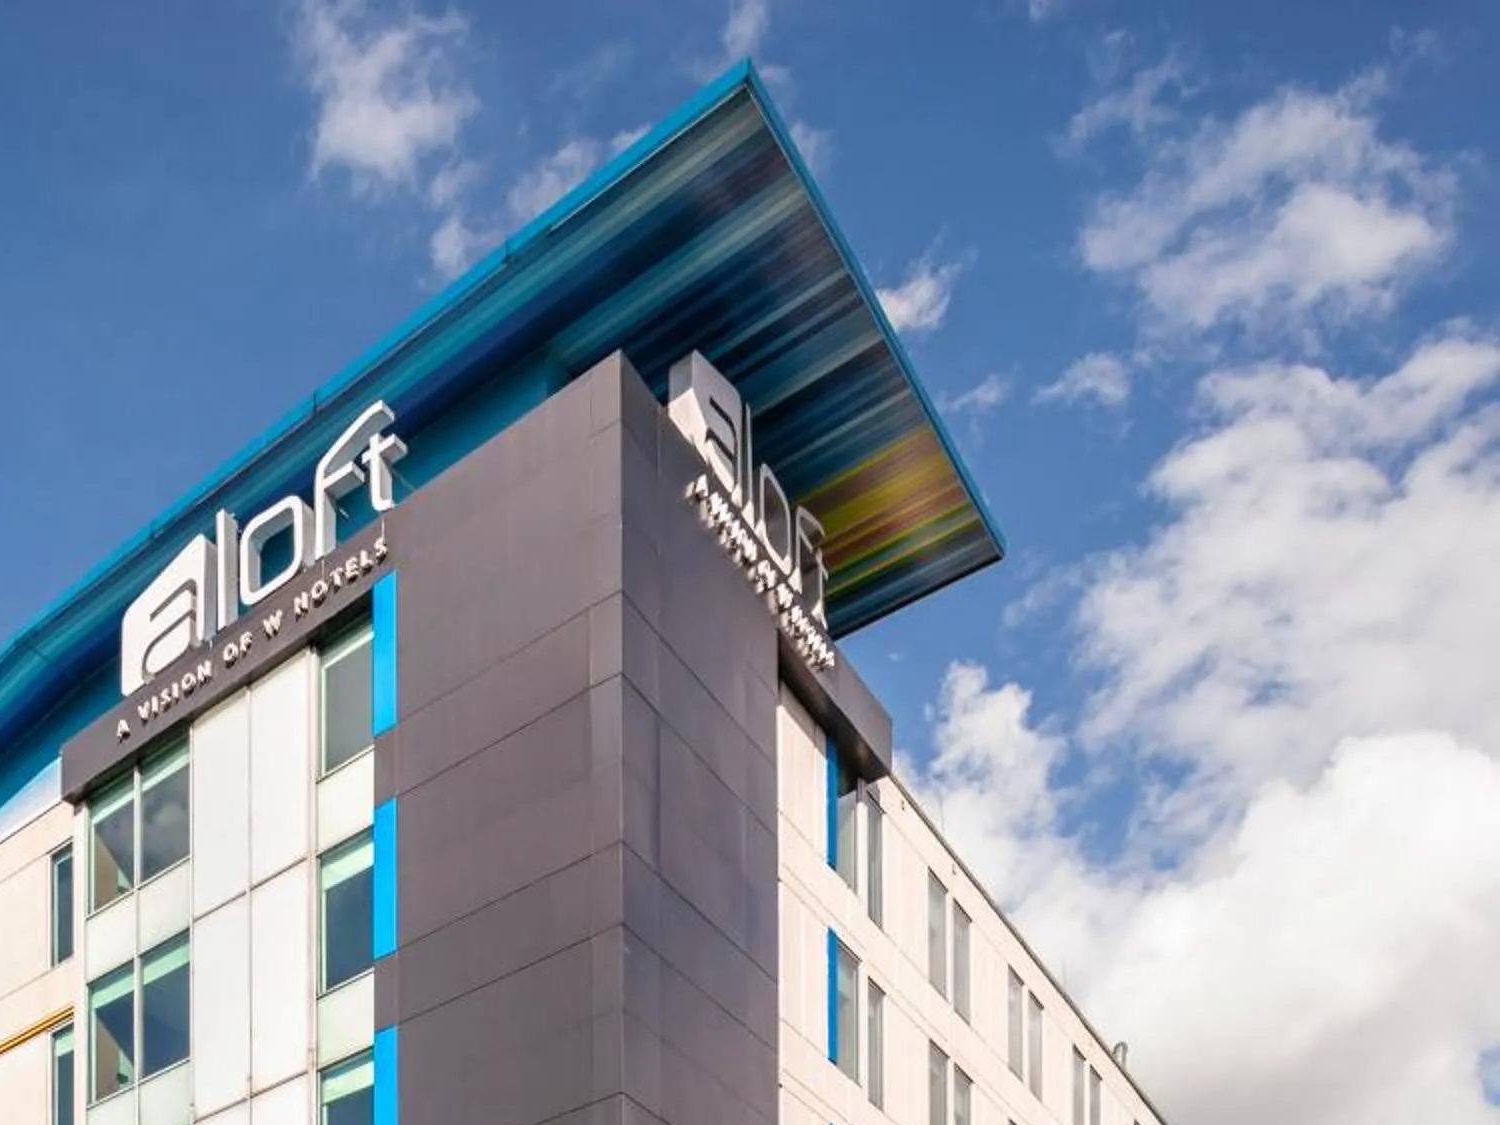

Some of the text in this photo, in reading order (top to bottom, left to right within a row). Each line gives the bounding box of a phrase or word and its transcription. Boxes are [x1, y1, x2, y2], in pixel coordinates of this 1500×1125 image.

[121, 399, 407, 697] aloft
[116, 719, 131, 739] A
[137, 660, 212, 722] VISION
[222, 631, 253, 664] OF
[262, 608, 283, 637] W
